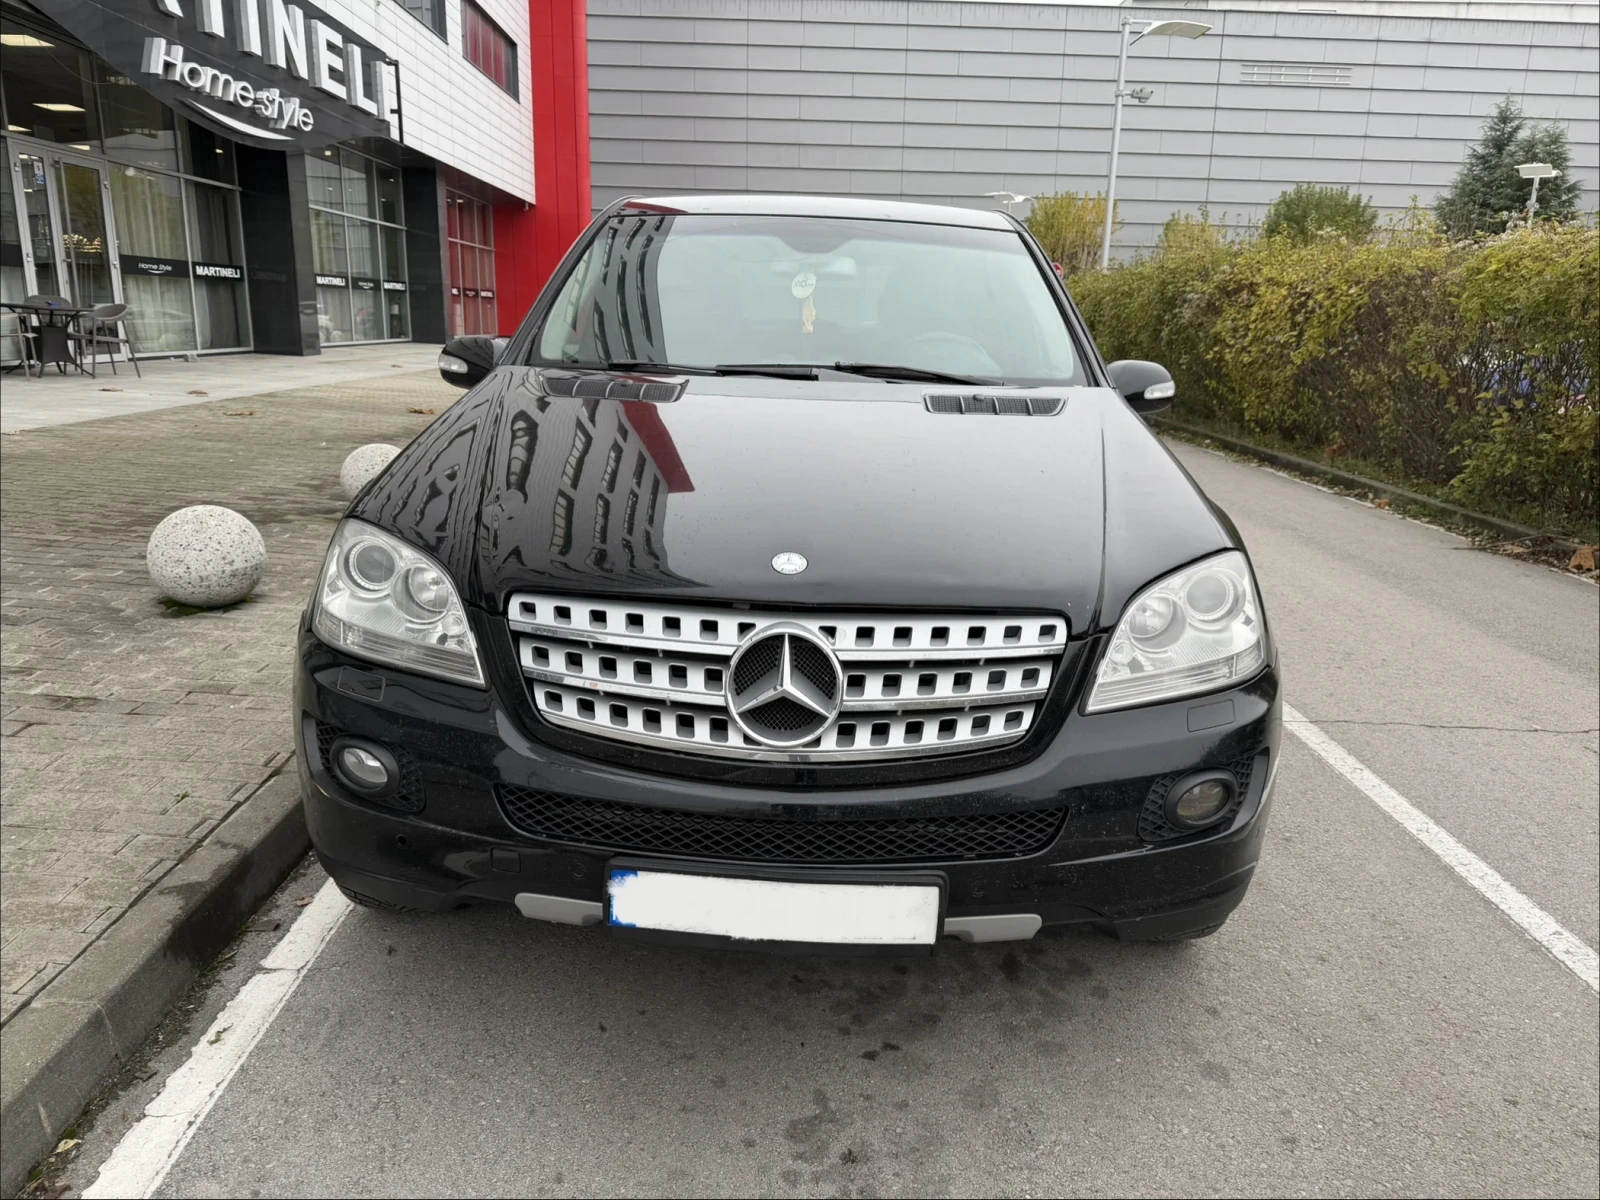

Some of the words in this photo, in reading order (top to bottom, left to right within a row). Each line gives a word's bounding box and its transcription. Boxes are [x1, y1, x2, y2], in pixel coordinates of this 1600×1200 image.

[140, 37, 255, 108] Home
[138, 262, 158, 270] Home
[195, 265, 240, 278] MARTINELI
[316, 275, 346, 286] MARTINELI
[383, 281, 406, 290] MARTINELI
